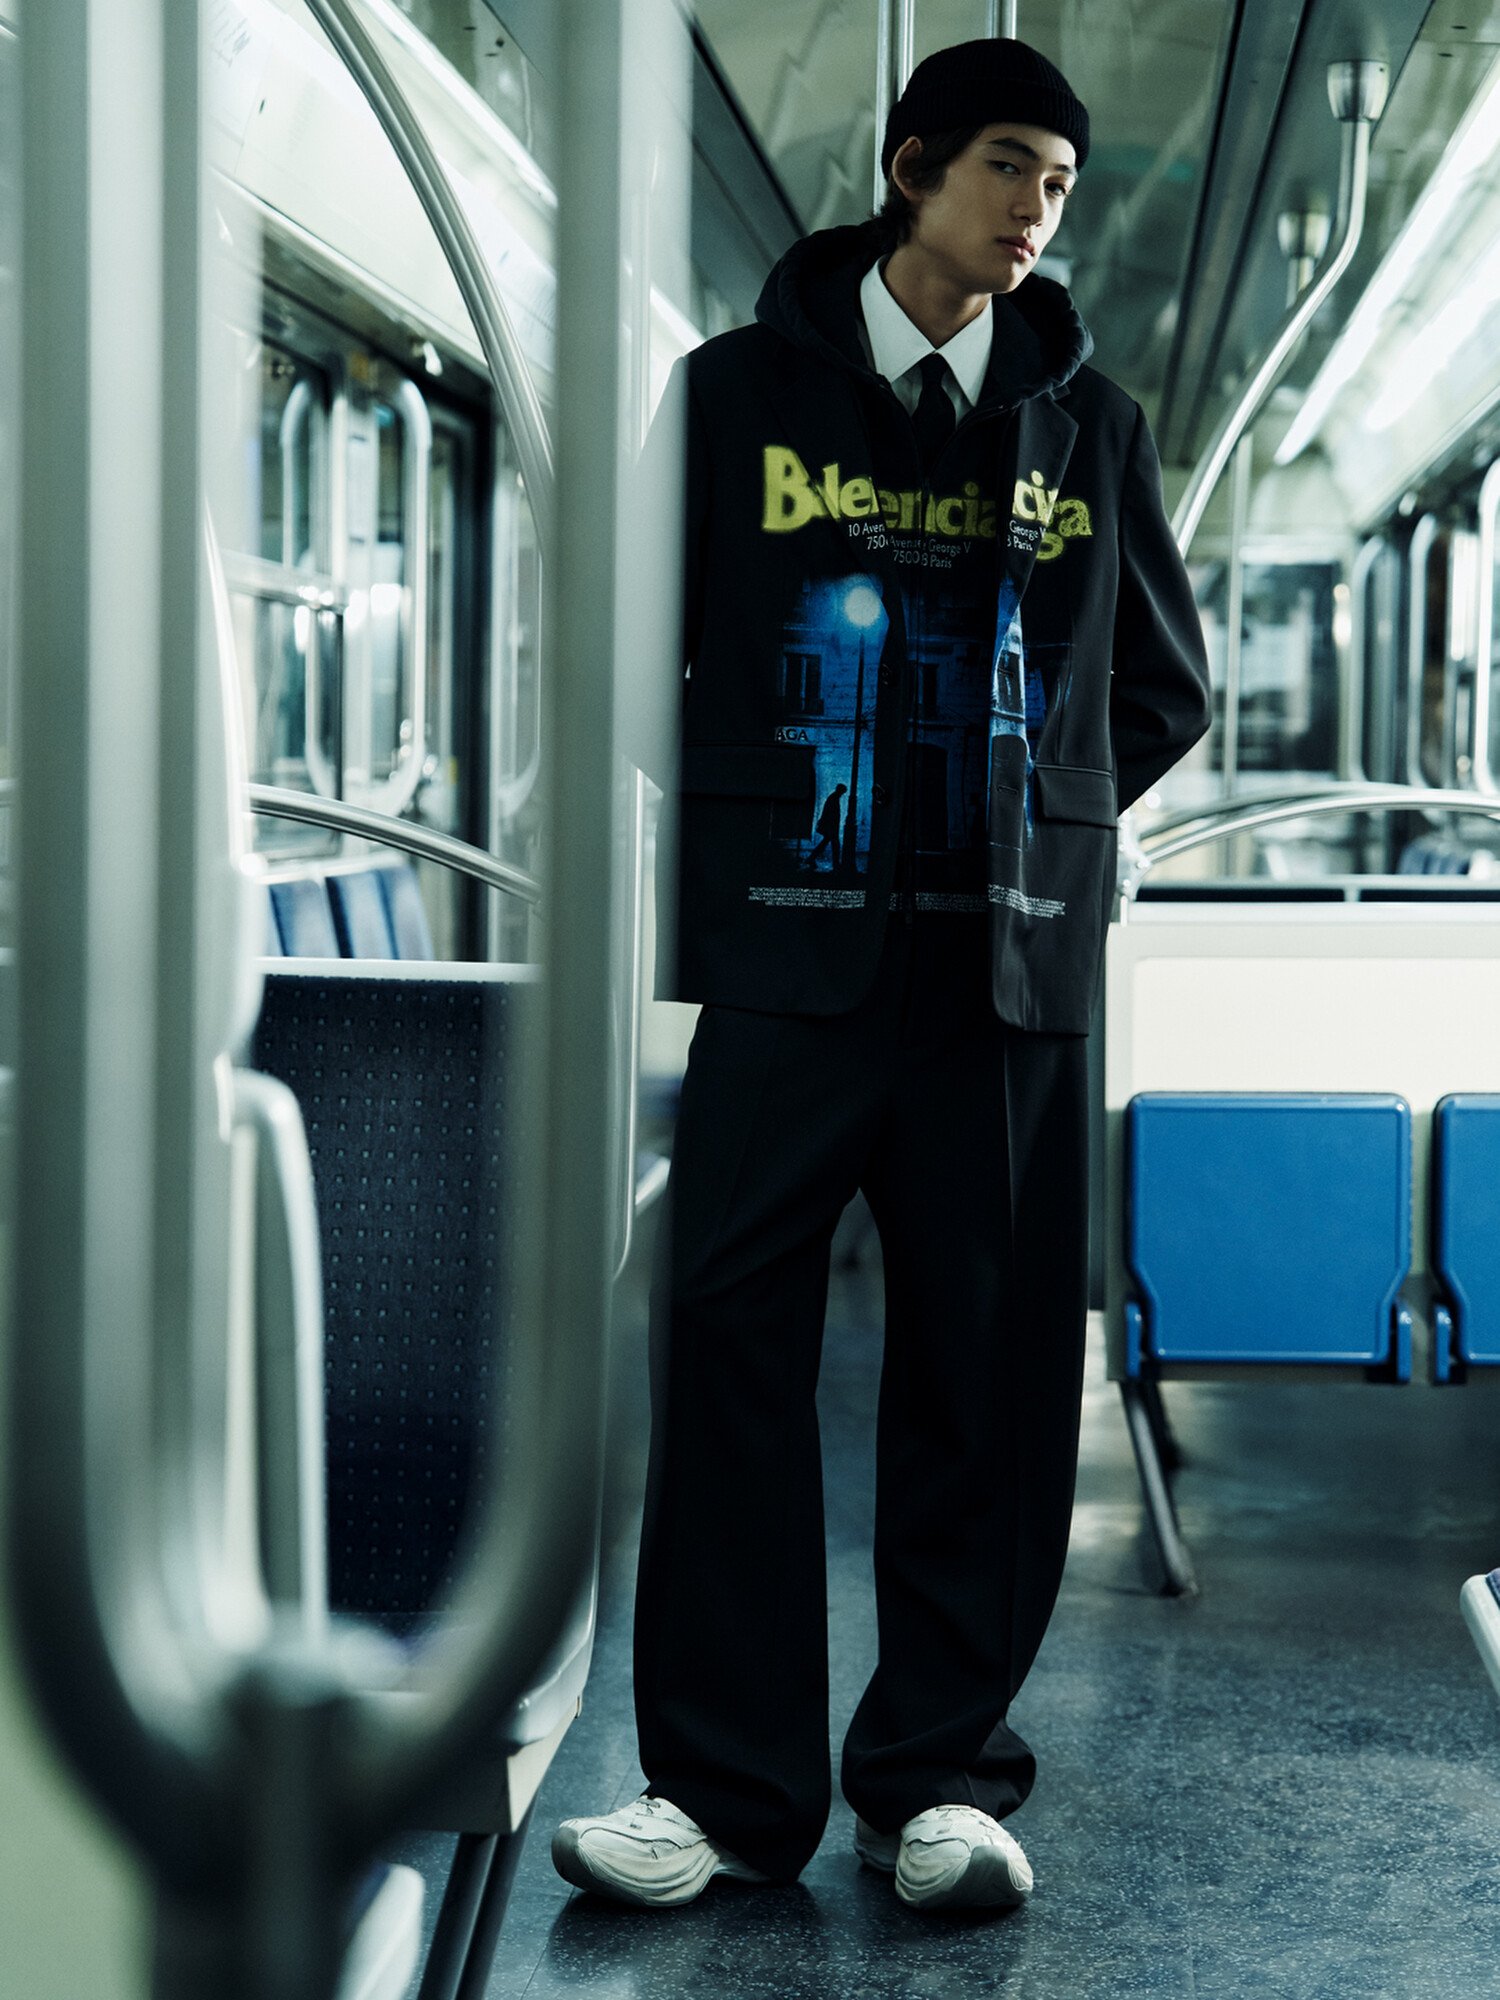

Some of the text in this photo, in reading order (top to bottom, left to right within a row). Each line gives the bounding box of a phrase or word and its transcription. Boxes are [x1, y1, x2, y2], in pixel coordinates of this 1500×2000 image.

[848, 523, 860, 537] 10
[1009, 520, 1039, 541] George
[866, 534, 889, 550] 750
[928, 538, 961, 557] George
[963, 541, 972, 554] V
[1013, 536, 1034, 552] Paris
[930, 554, 952, 569] Paris
